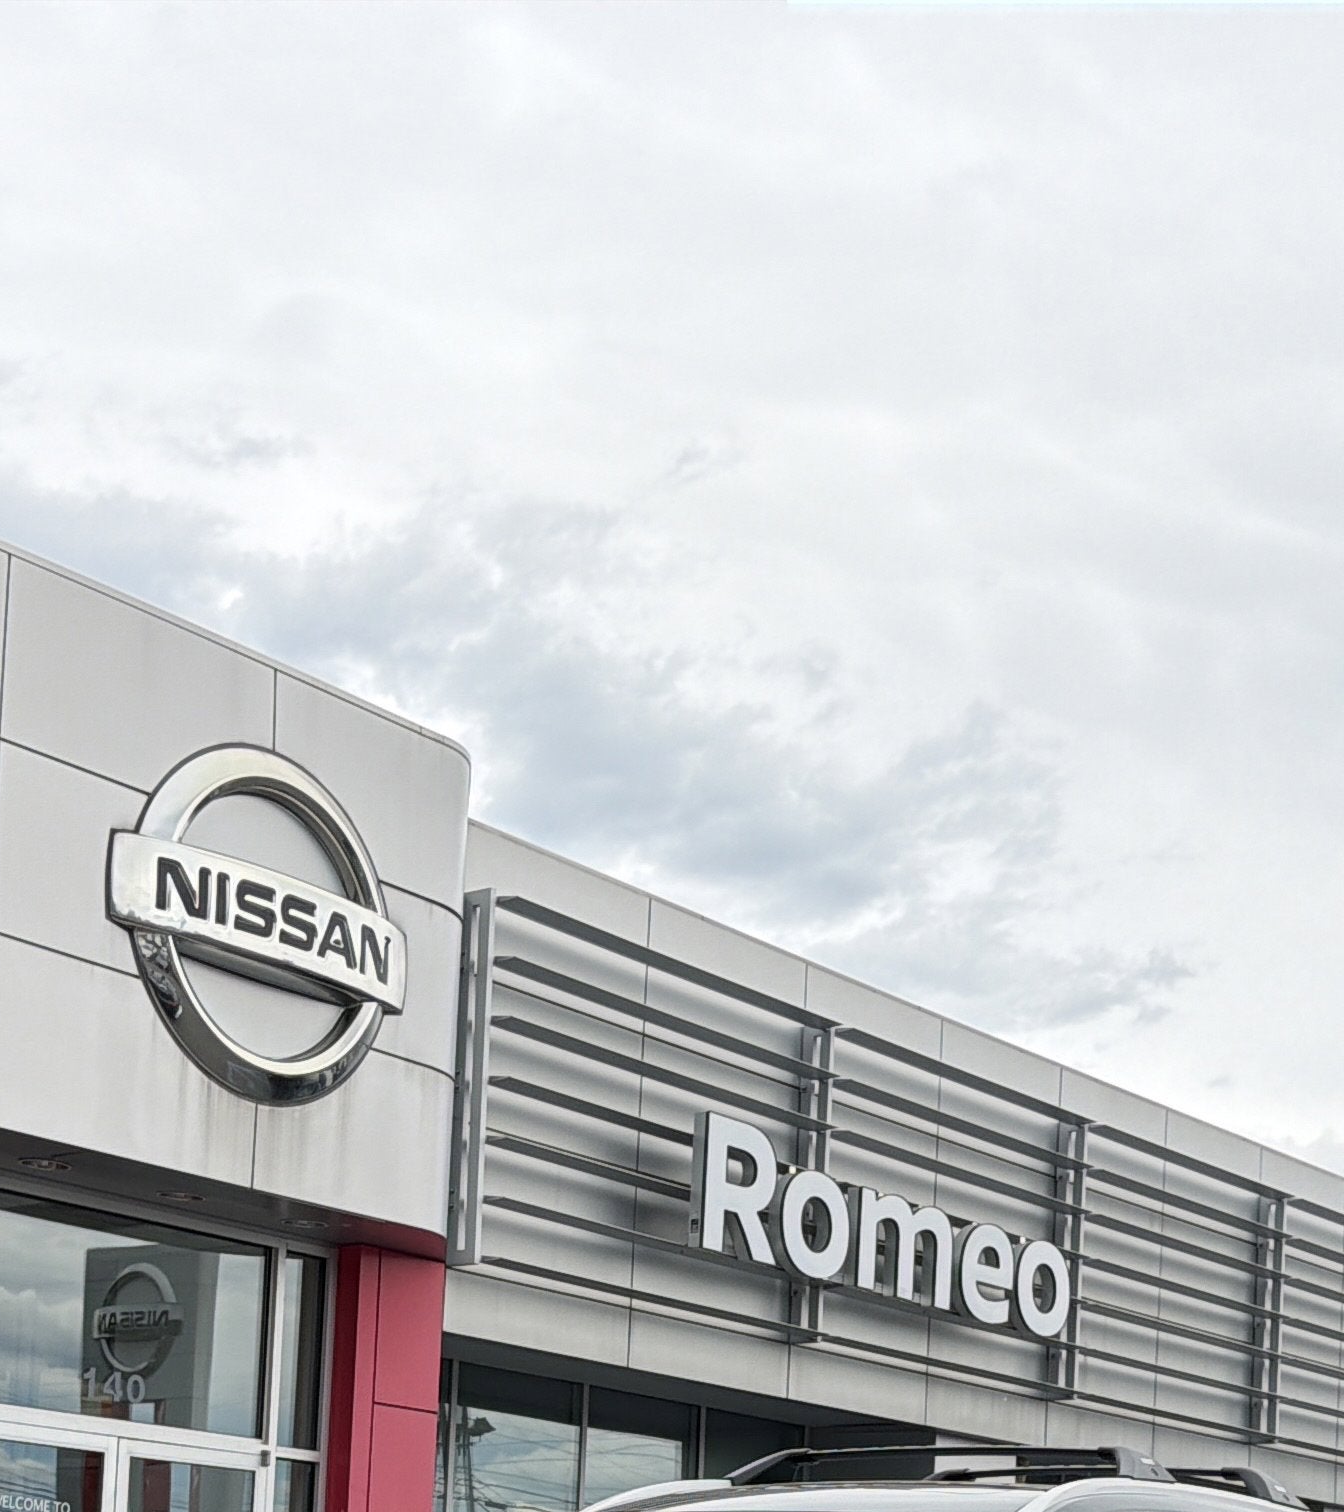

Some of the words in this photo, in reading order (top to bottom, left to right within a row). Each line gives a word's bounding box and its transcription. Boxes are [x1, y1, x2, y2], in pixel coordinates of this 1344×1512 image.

[154, 855, 392, 986] NISSAN
[696, 1109, 1071, 1338] Romeo
[83, 1366, 146, 1404] 140
